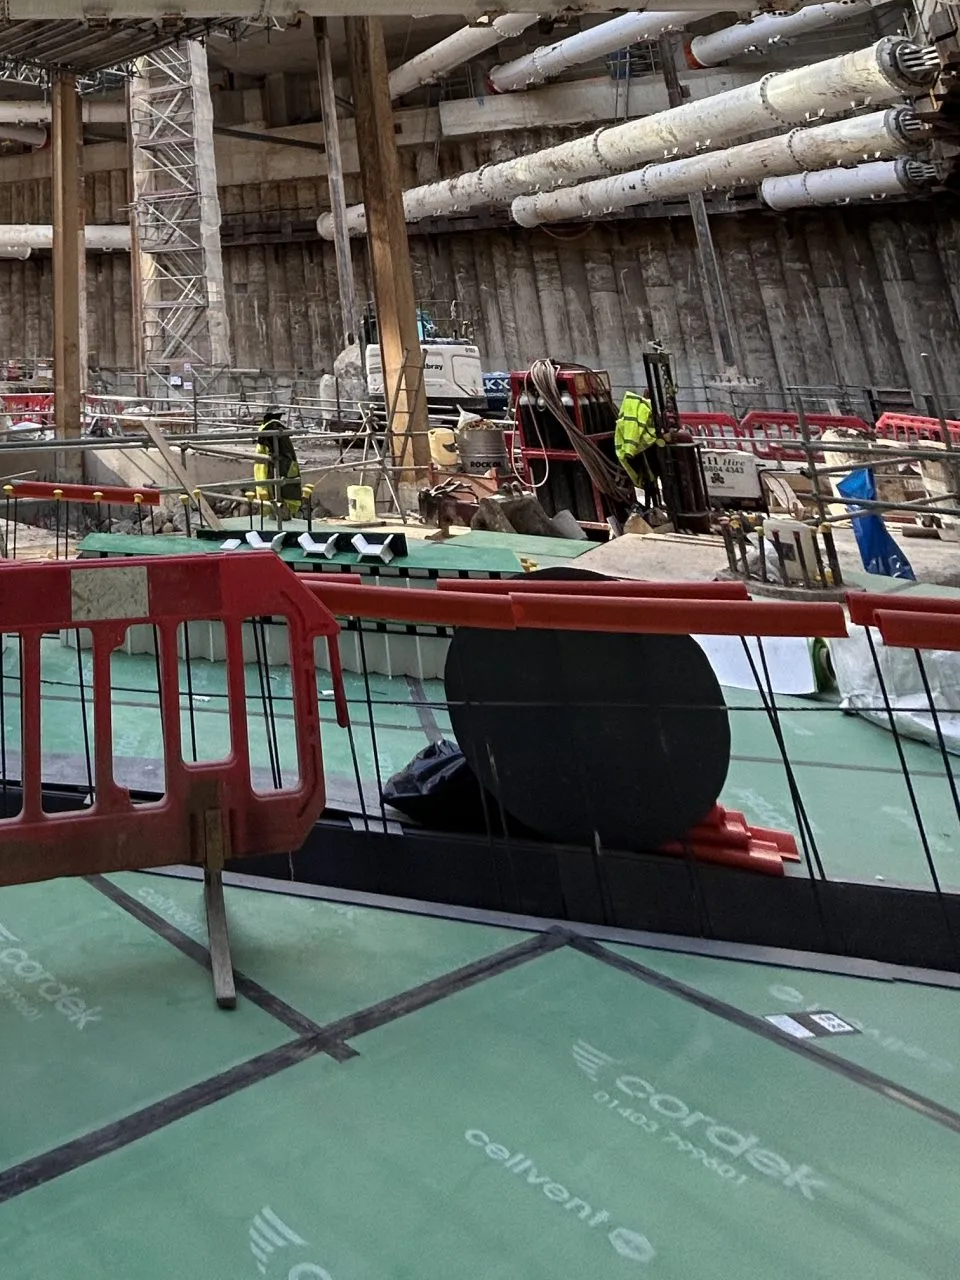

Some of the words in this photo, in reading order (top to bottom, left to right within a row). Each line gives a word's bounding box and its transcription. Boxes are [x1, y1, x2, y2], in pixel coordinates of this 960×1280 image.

[0, 947, 103, 1030] cordek
[592, 1090, 659, 1133] 01403
[615, 1074, 828, 1201] cordek
[464, 1128, 611, 1227] cellvent
